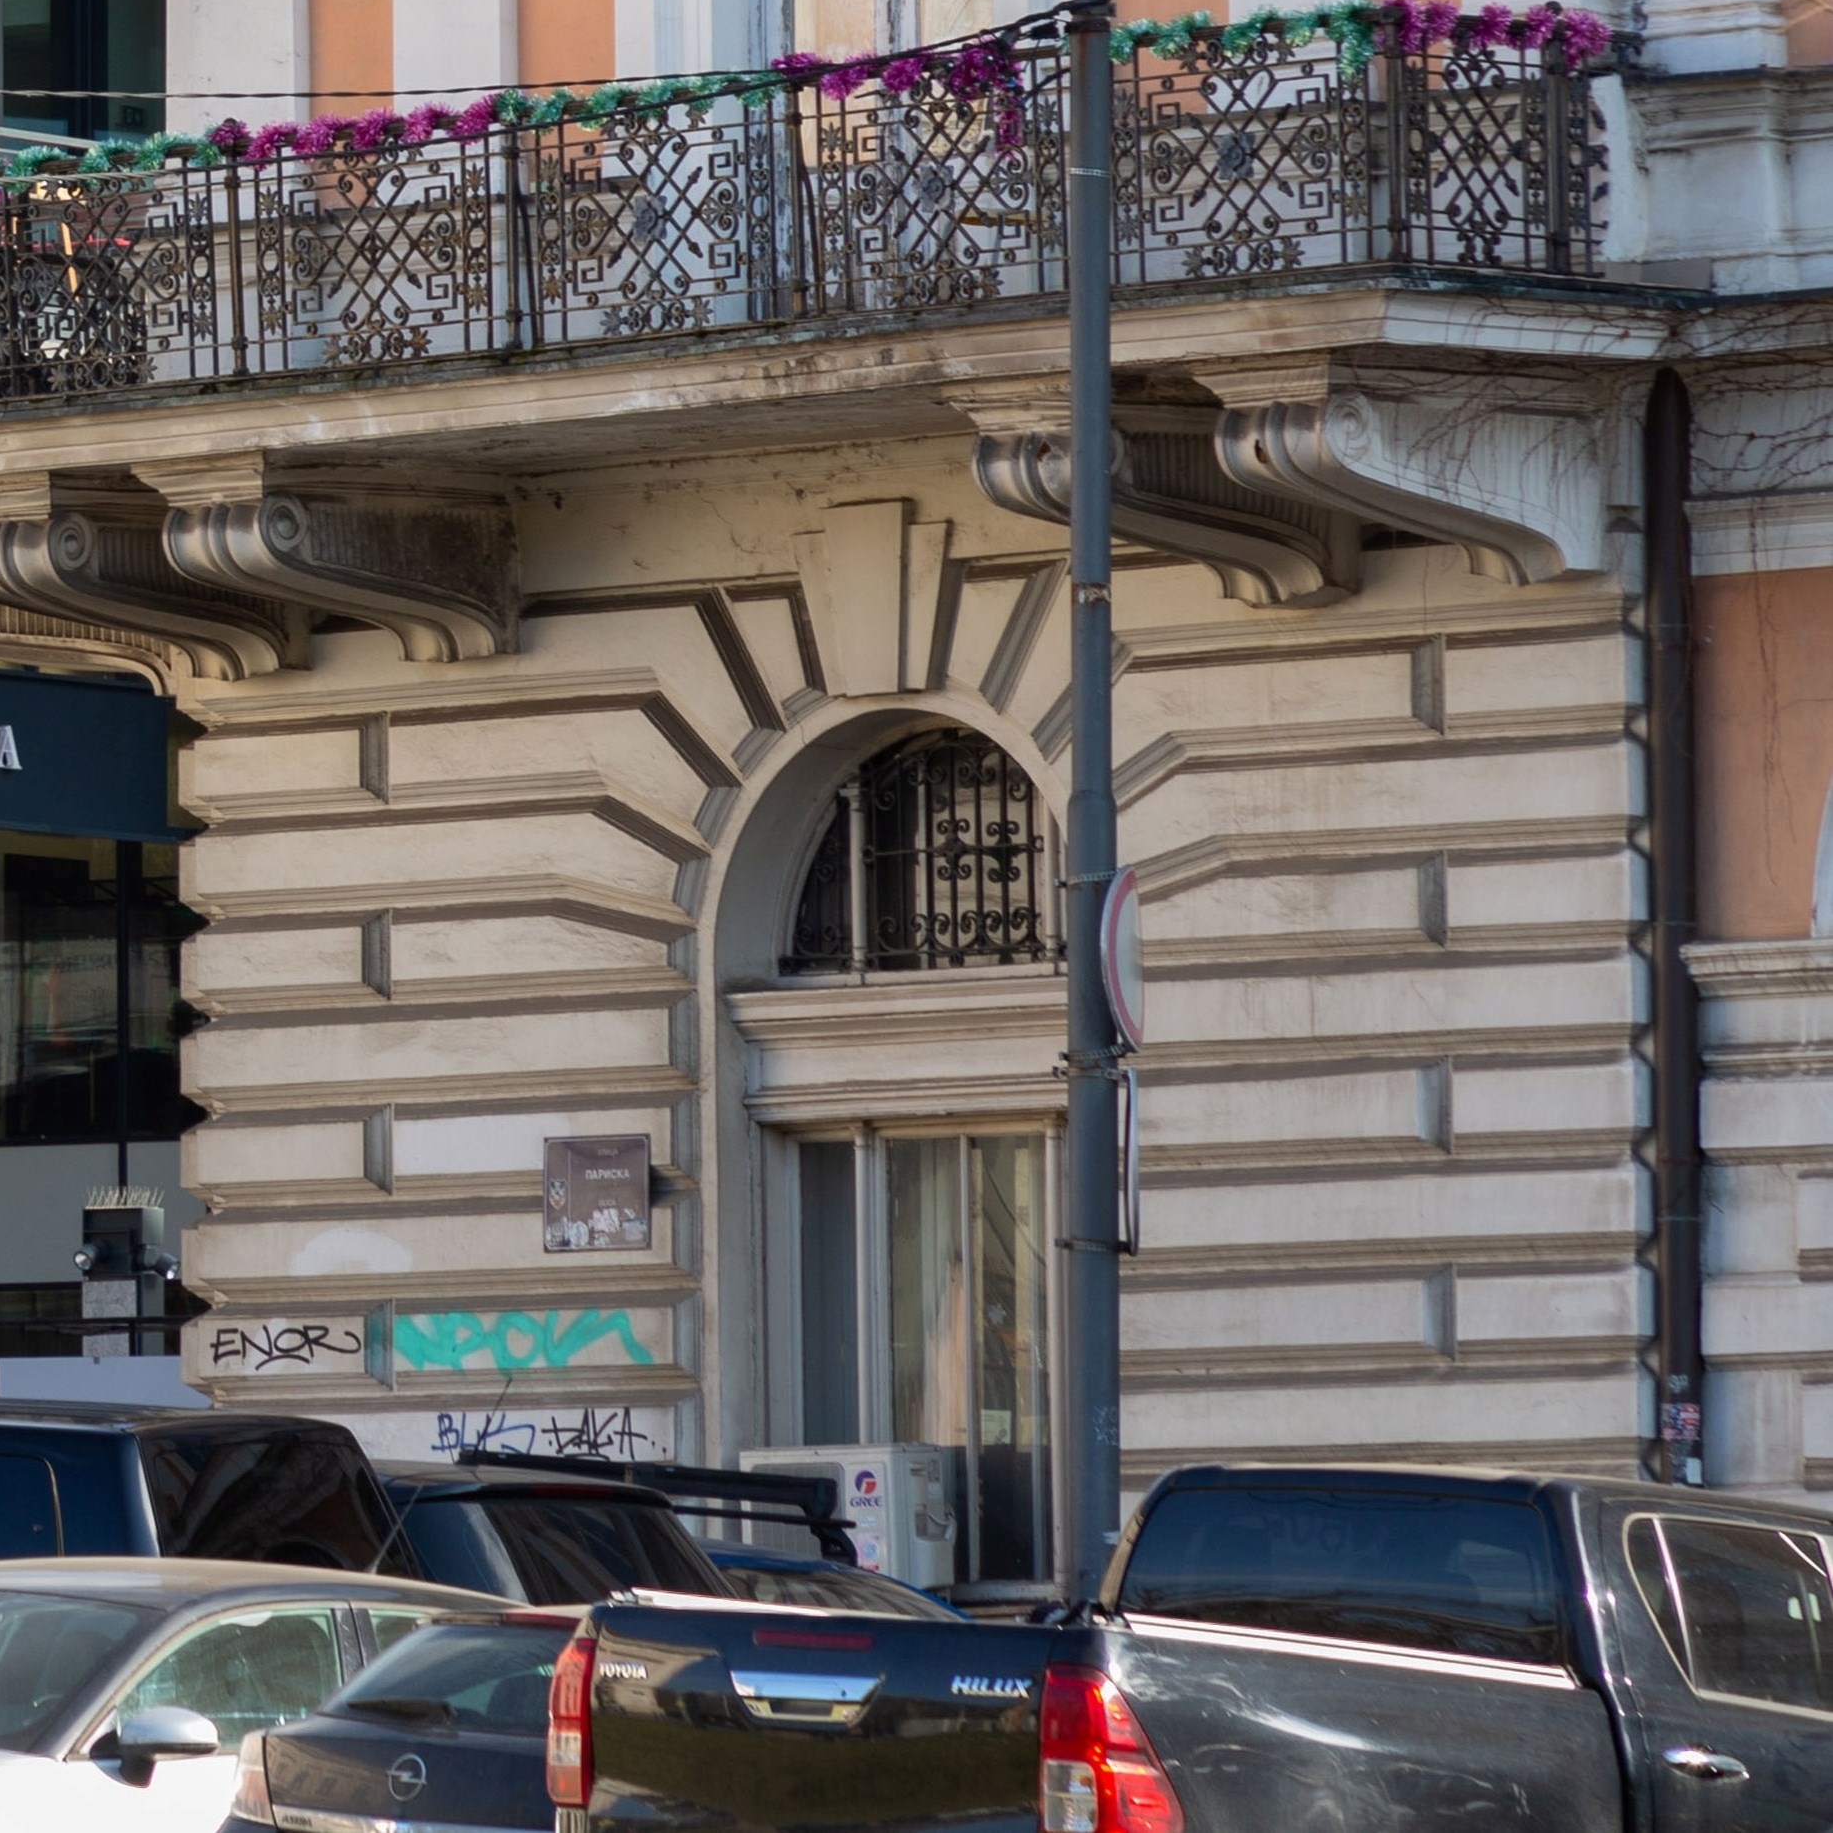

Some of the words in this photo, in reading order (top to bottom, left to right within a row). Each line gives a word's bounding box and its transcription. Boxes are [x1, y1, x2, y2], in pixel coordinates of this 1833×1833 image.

[585, 1168, 631, 1181] ПАРИСКА
[599, 1663, 648, 1680] TOYOTA
[951, 1675, 1033, 1699] HILUX
